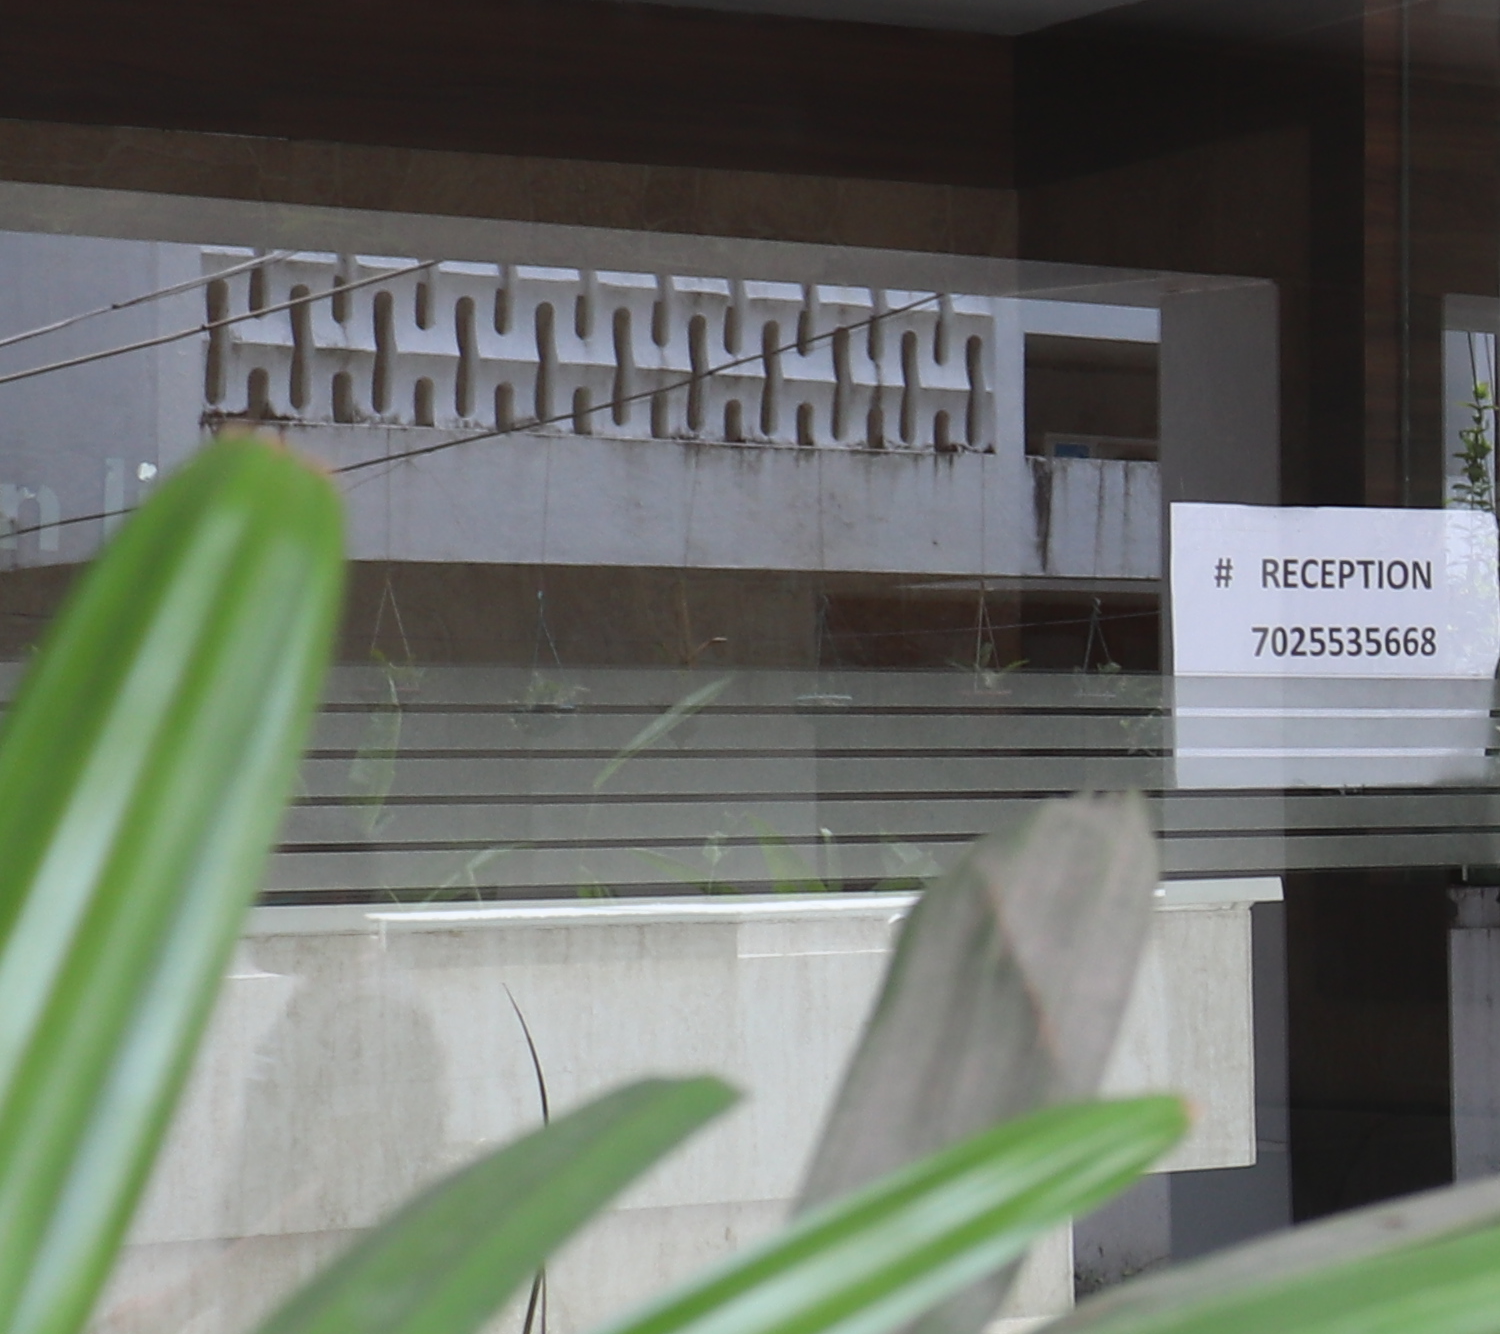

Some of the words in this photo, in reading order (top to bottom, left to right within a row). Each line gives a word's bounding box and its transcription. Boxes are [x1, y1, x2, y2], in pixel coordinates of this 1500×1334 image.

[1214, 558, 1233, 588] #
[1261, 558, 1433, 590] RECEPTION
[1251, 625, 1437, 658] 7025535668
